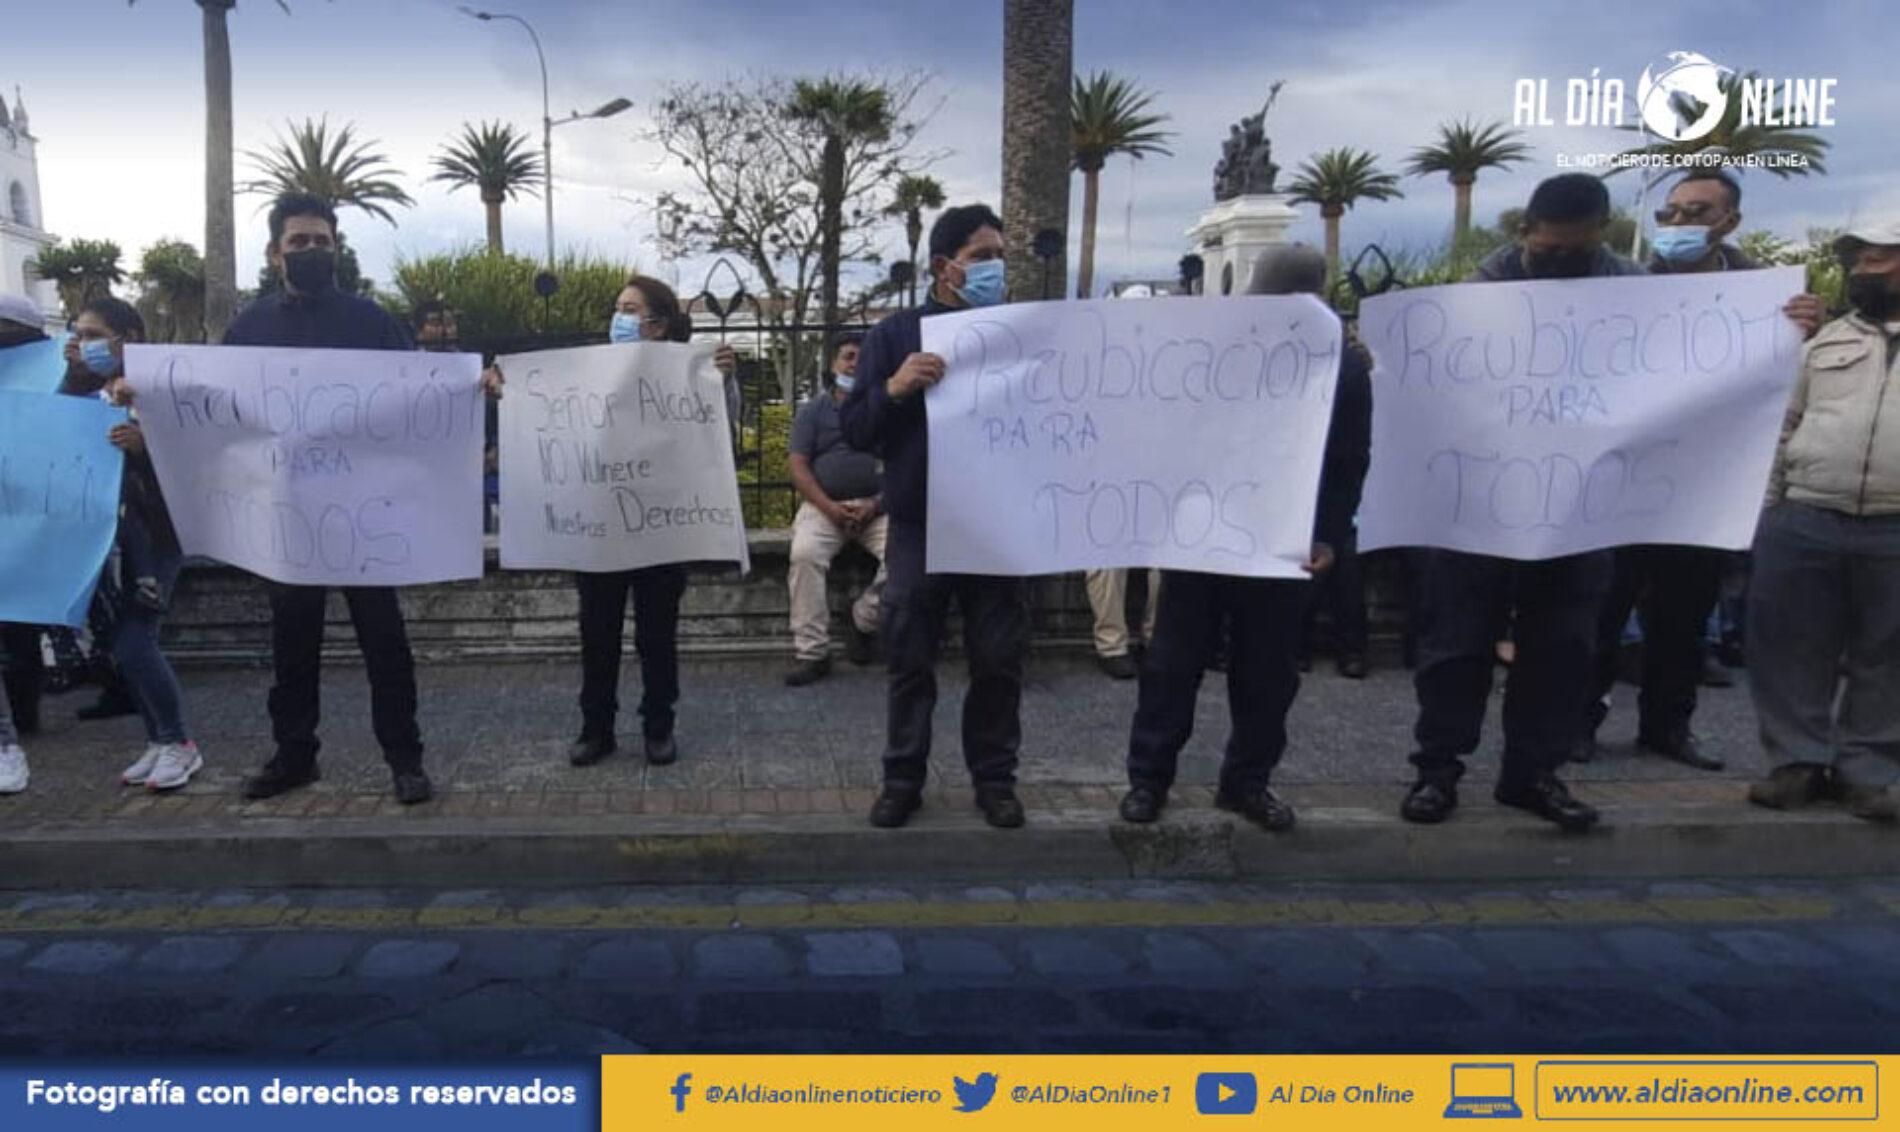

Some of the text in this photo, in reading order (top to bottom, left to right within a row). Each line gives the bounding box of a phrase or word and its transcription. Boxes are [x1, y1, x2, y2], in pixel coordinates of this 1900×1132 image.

[1497, 384, 1610, 428] PARA
[266, 445, 353, 476] PARA
[1427, 438, 1680, 532] TODOS
[1033, 479, 1261, 558] TODOS
